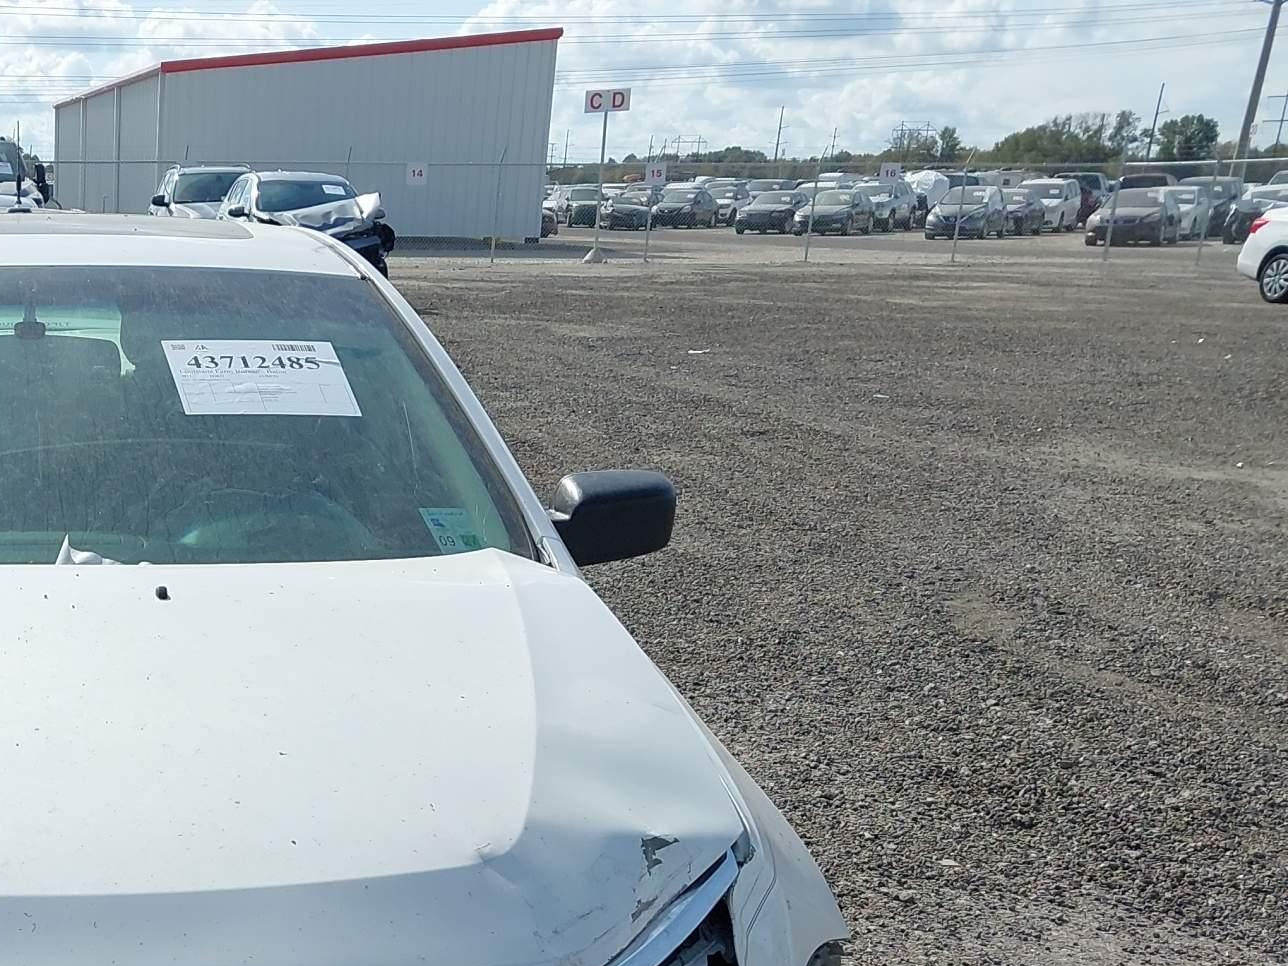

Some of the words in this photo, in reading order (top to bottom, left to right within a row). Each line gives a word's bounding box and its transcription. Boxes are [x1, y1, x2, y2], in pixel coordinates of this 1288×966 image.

[590, 92, 603, 110] C
[612, 91, 625, 109] D
[411, 169, 423, 177] 14
[650, 169, 663, 178] 15
[186, 355, 321, 370] 43712485
[438, 535, 456, 547] 09
